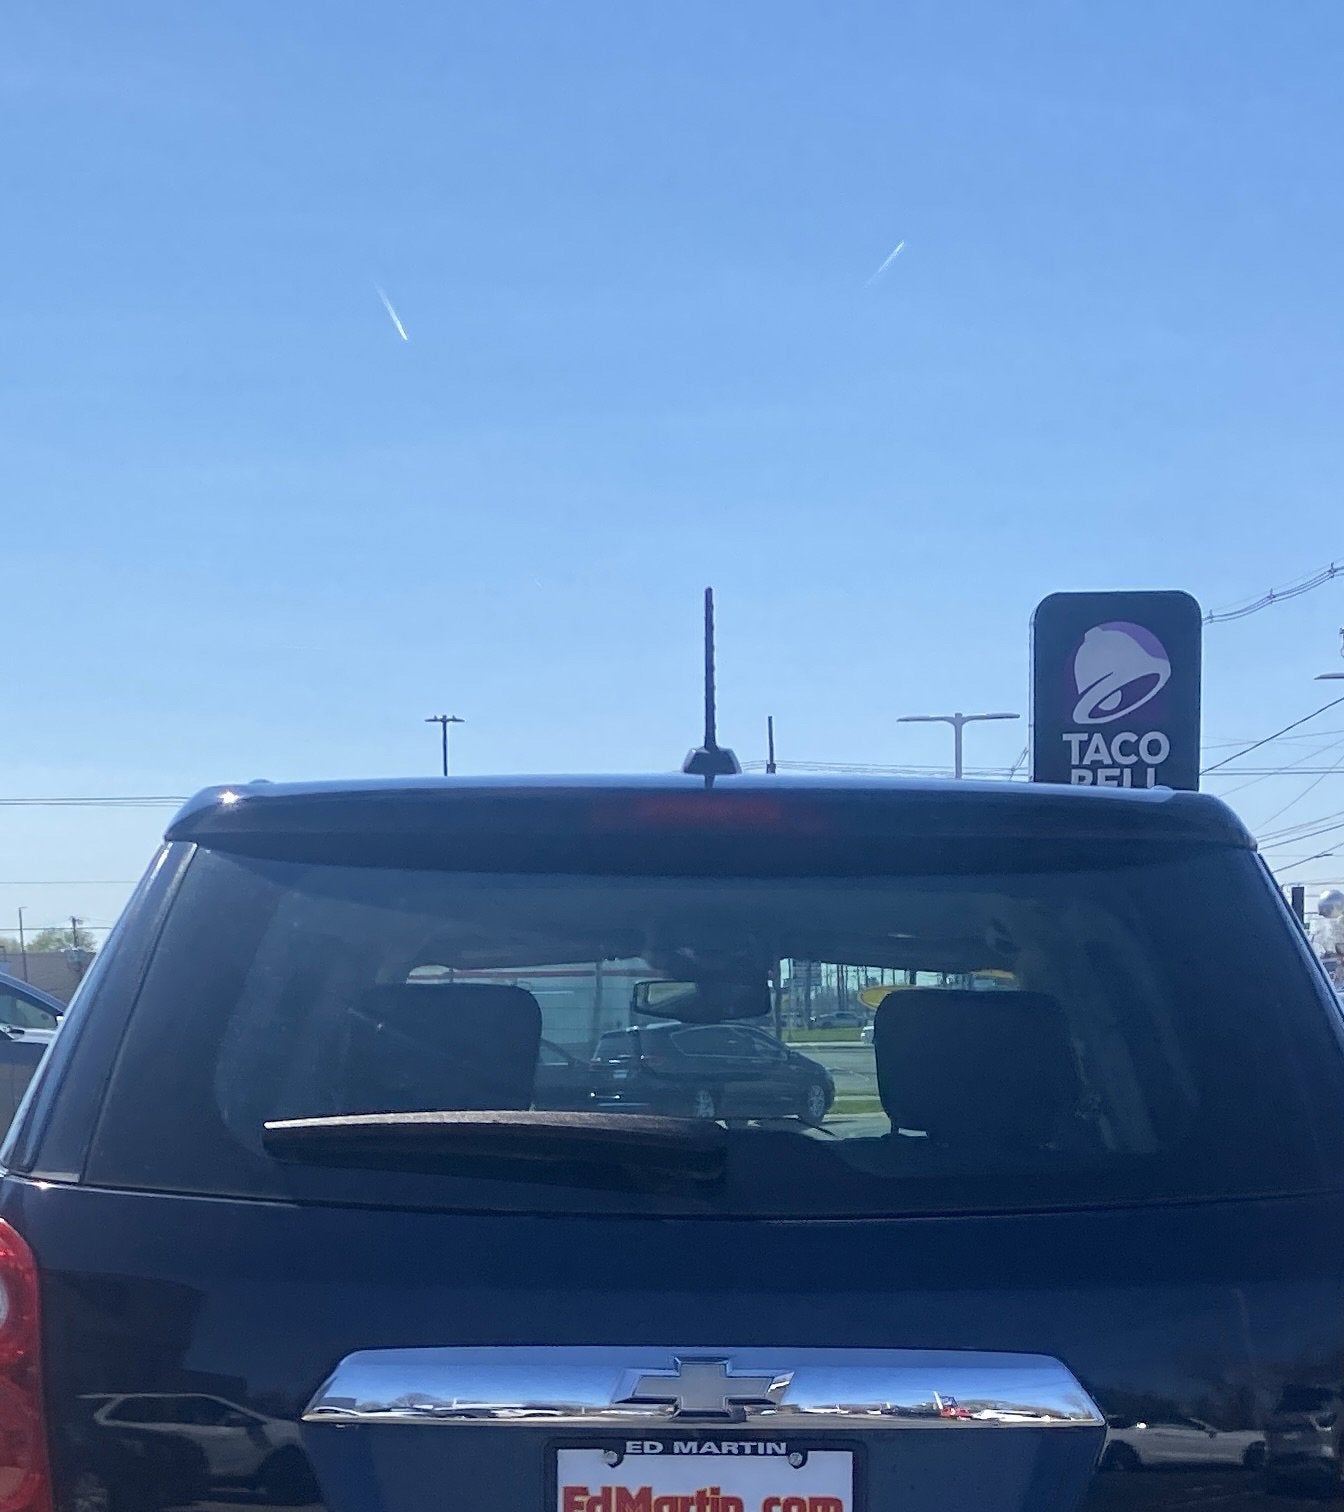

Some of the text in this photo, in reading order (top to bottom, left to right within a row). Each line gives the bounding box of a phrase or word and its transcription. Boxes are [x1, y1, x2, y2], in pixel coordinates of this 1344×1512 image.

[1062, 730, 1170, 765] TACO
[625, 1441, 787, 1455] ED MARTIN
